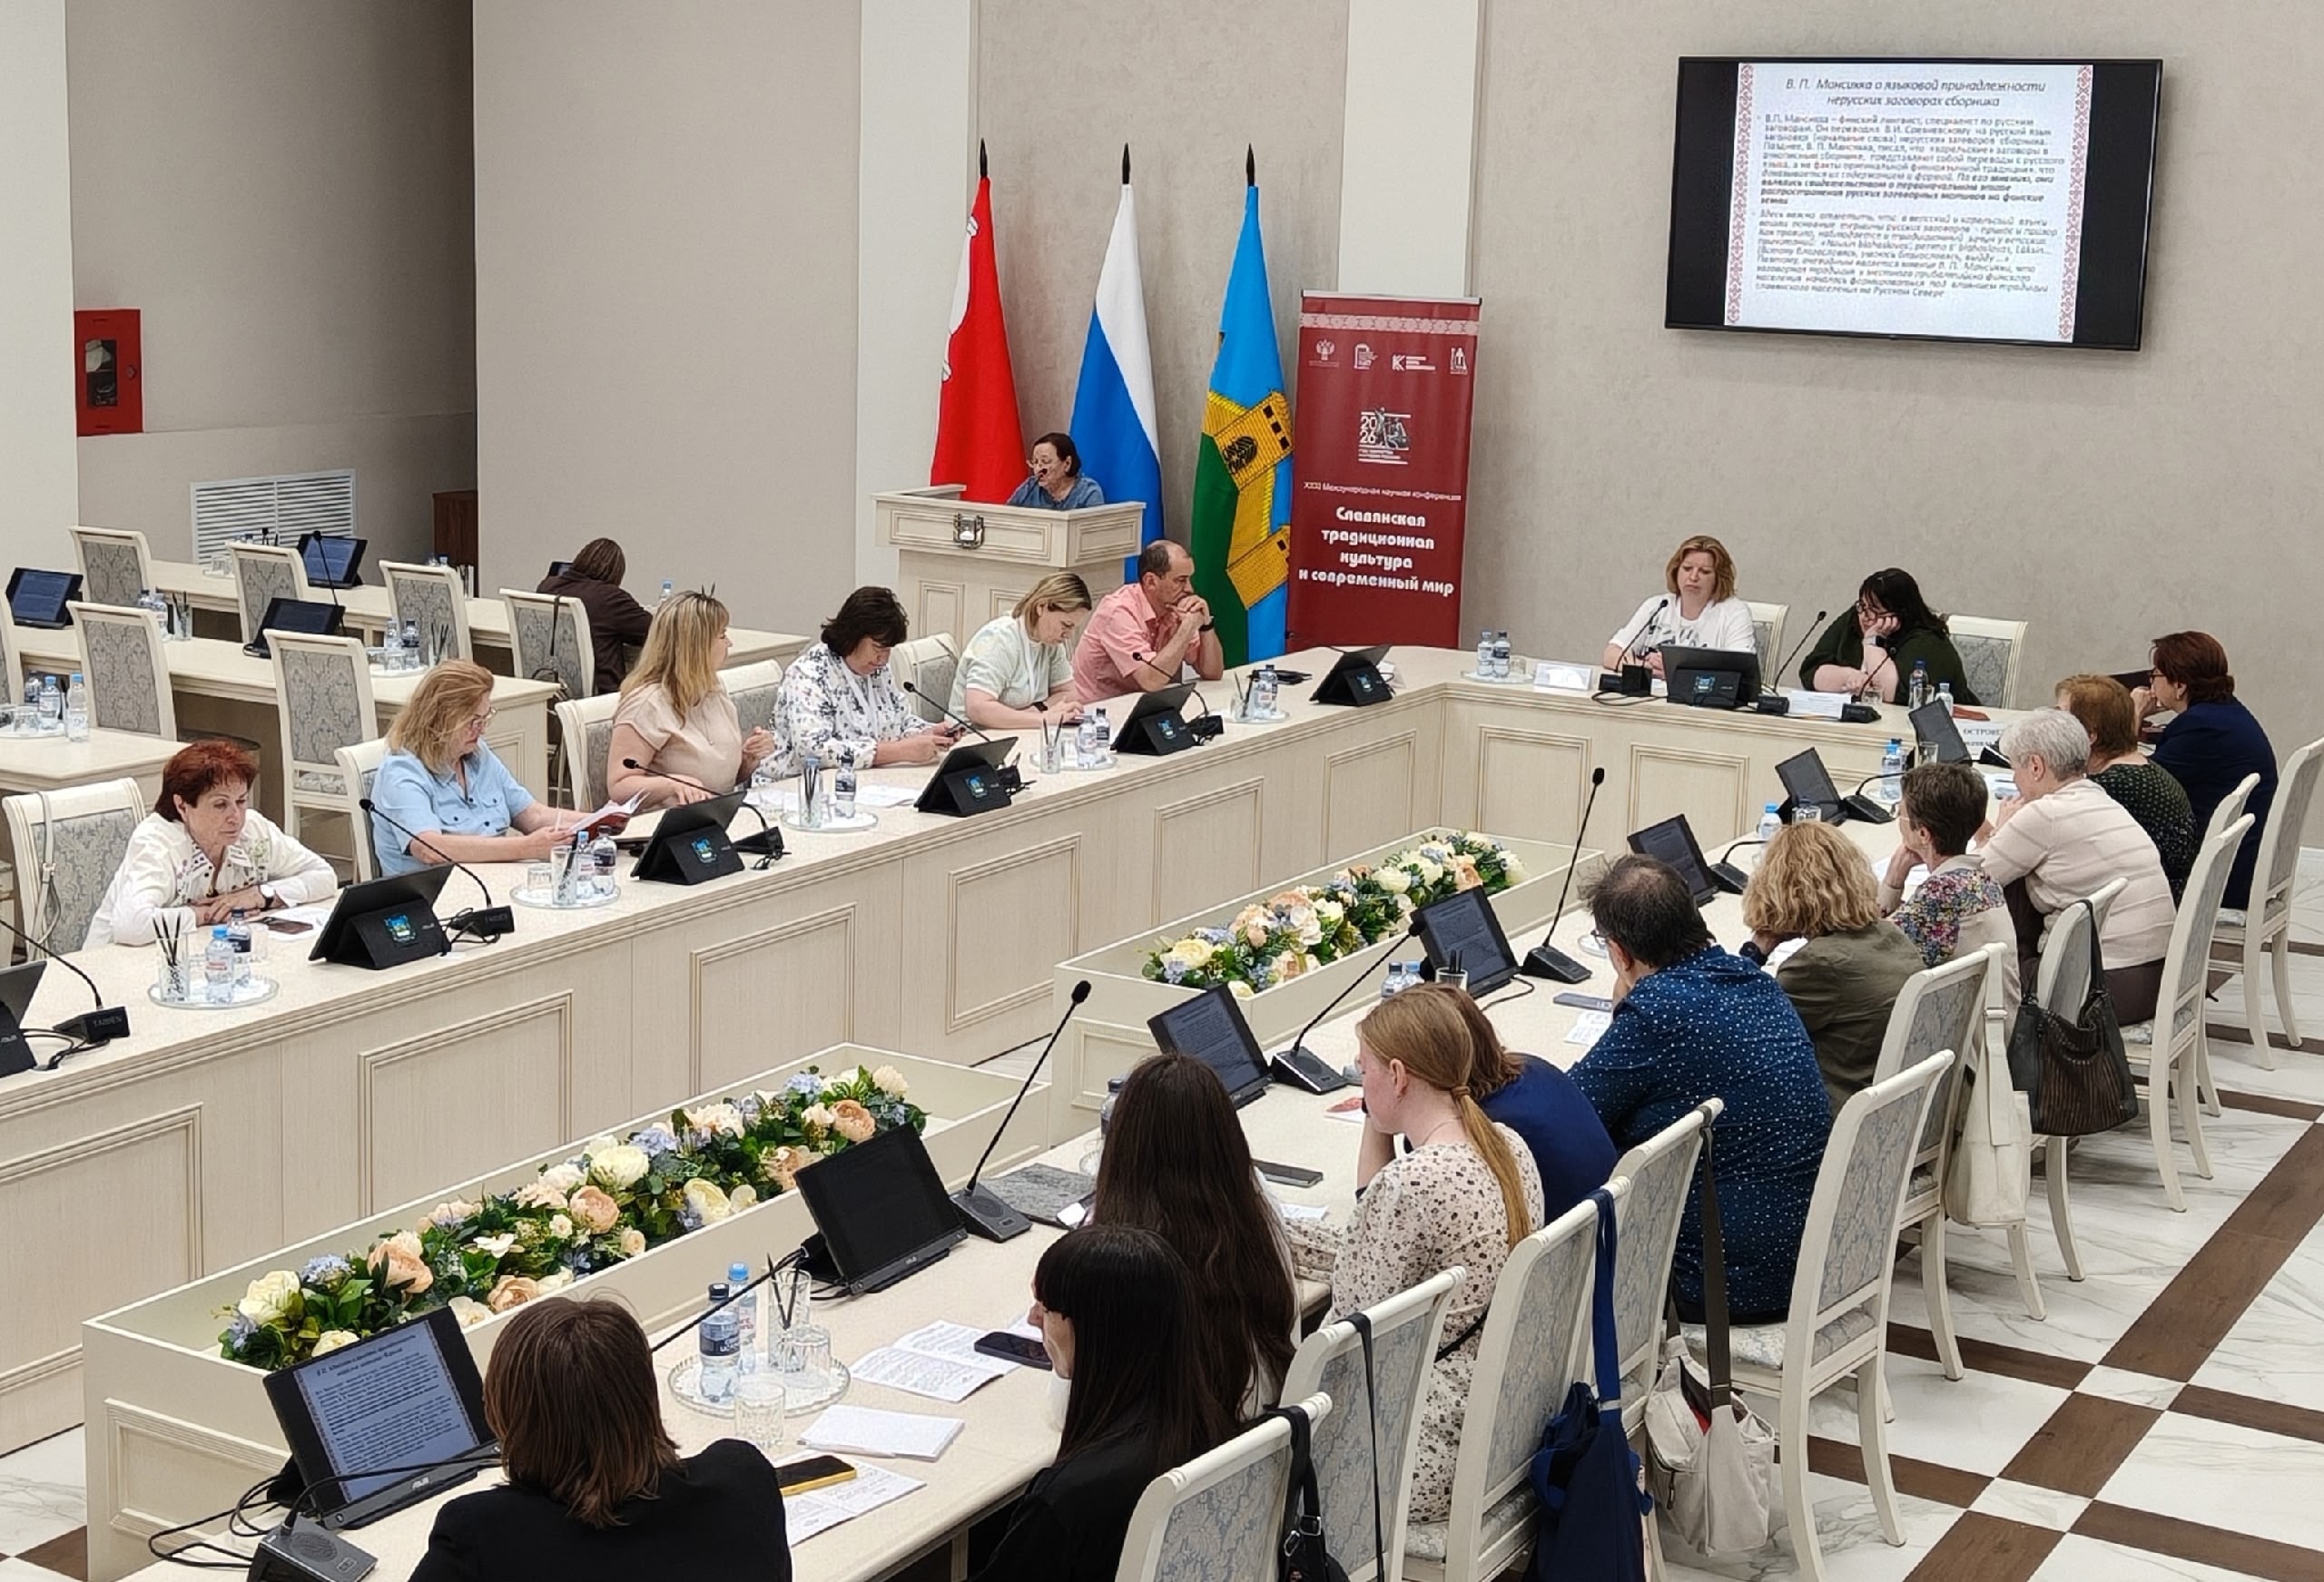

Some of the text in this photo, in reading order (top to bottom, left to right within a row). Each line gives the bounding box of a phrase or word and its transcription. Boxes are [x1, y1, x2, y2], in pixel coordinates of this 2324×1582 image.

[1786, 79, 2045, 93] В. П. Мансикка о языковой принадлежности
[1827, 95, 2000, 108] нерусских заговорах сборника
[1360, 416, 1376, 430] 20
[1359, 429, 1376, 444] 26
[1336, 506, 1425, 527] Славянская
[1321, 529, 1434, 550] традиционная
[1340, 552, 1413, 571] культура
[1298, 569, 1454, 597] и современный мир
